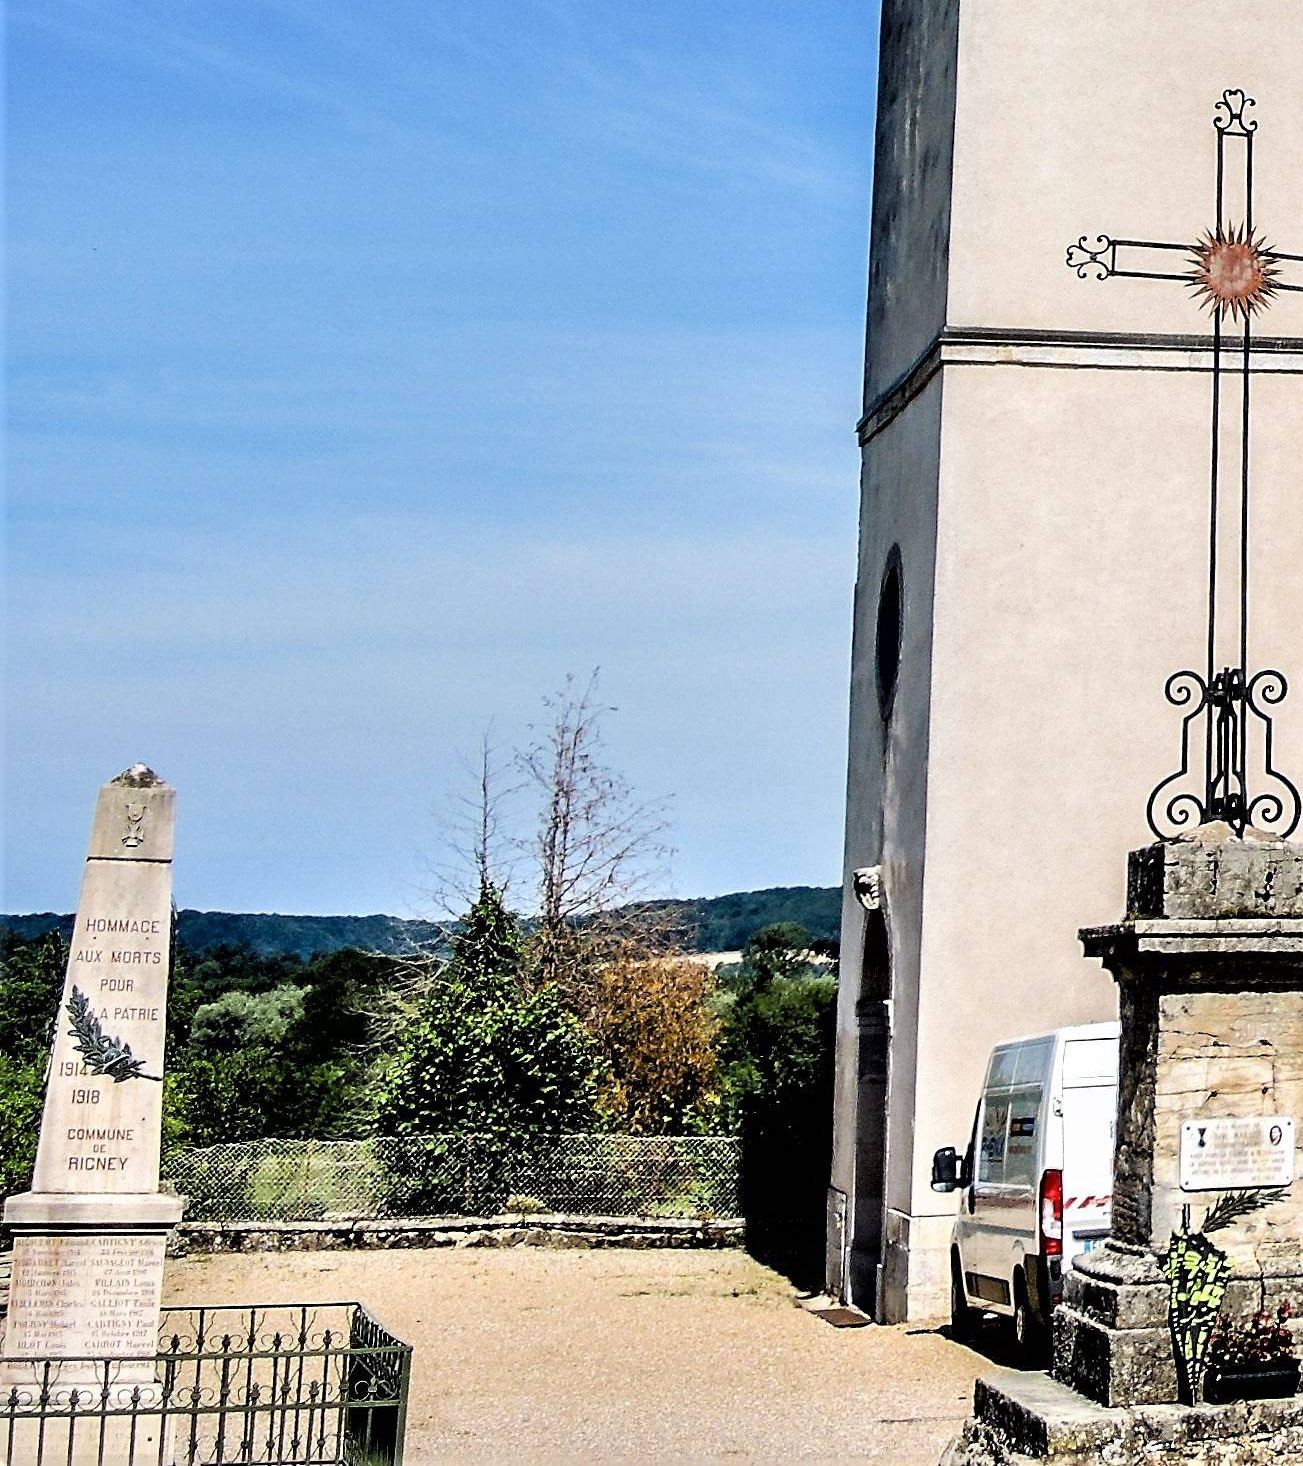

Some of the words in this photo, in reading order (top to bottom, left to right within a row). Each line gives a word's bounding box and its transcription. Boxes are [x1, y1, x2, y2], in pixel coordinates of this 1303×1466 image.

[86, 919, 160, 933] HOMMAGE
[76, 950, 102, 963] AUX
[111, 951, 161, 964] MORTS
[101, 978, 134, 992] POUR
[114, 1008, 159, 1021] PATRIE
[60, 1062, 87, 1076] 1914
[72, 1089, 100, 1104] 1918
[68, 1129, 134, 1141] COMMUNE
[93, 1144, 106, 1153] DE
[68, 1157, 128, 1170] RIGNEY
